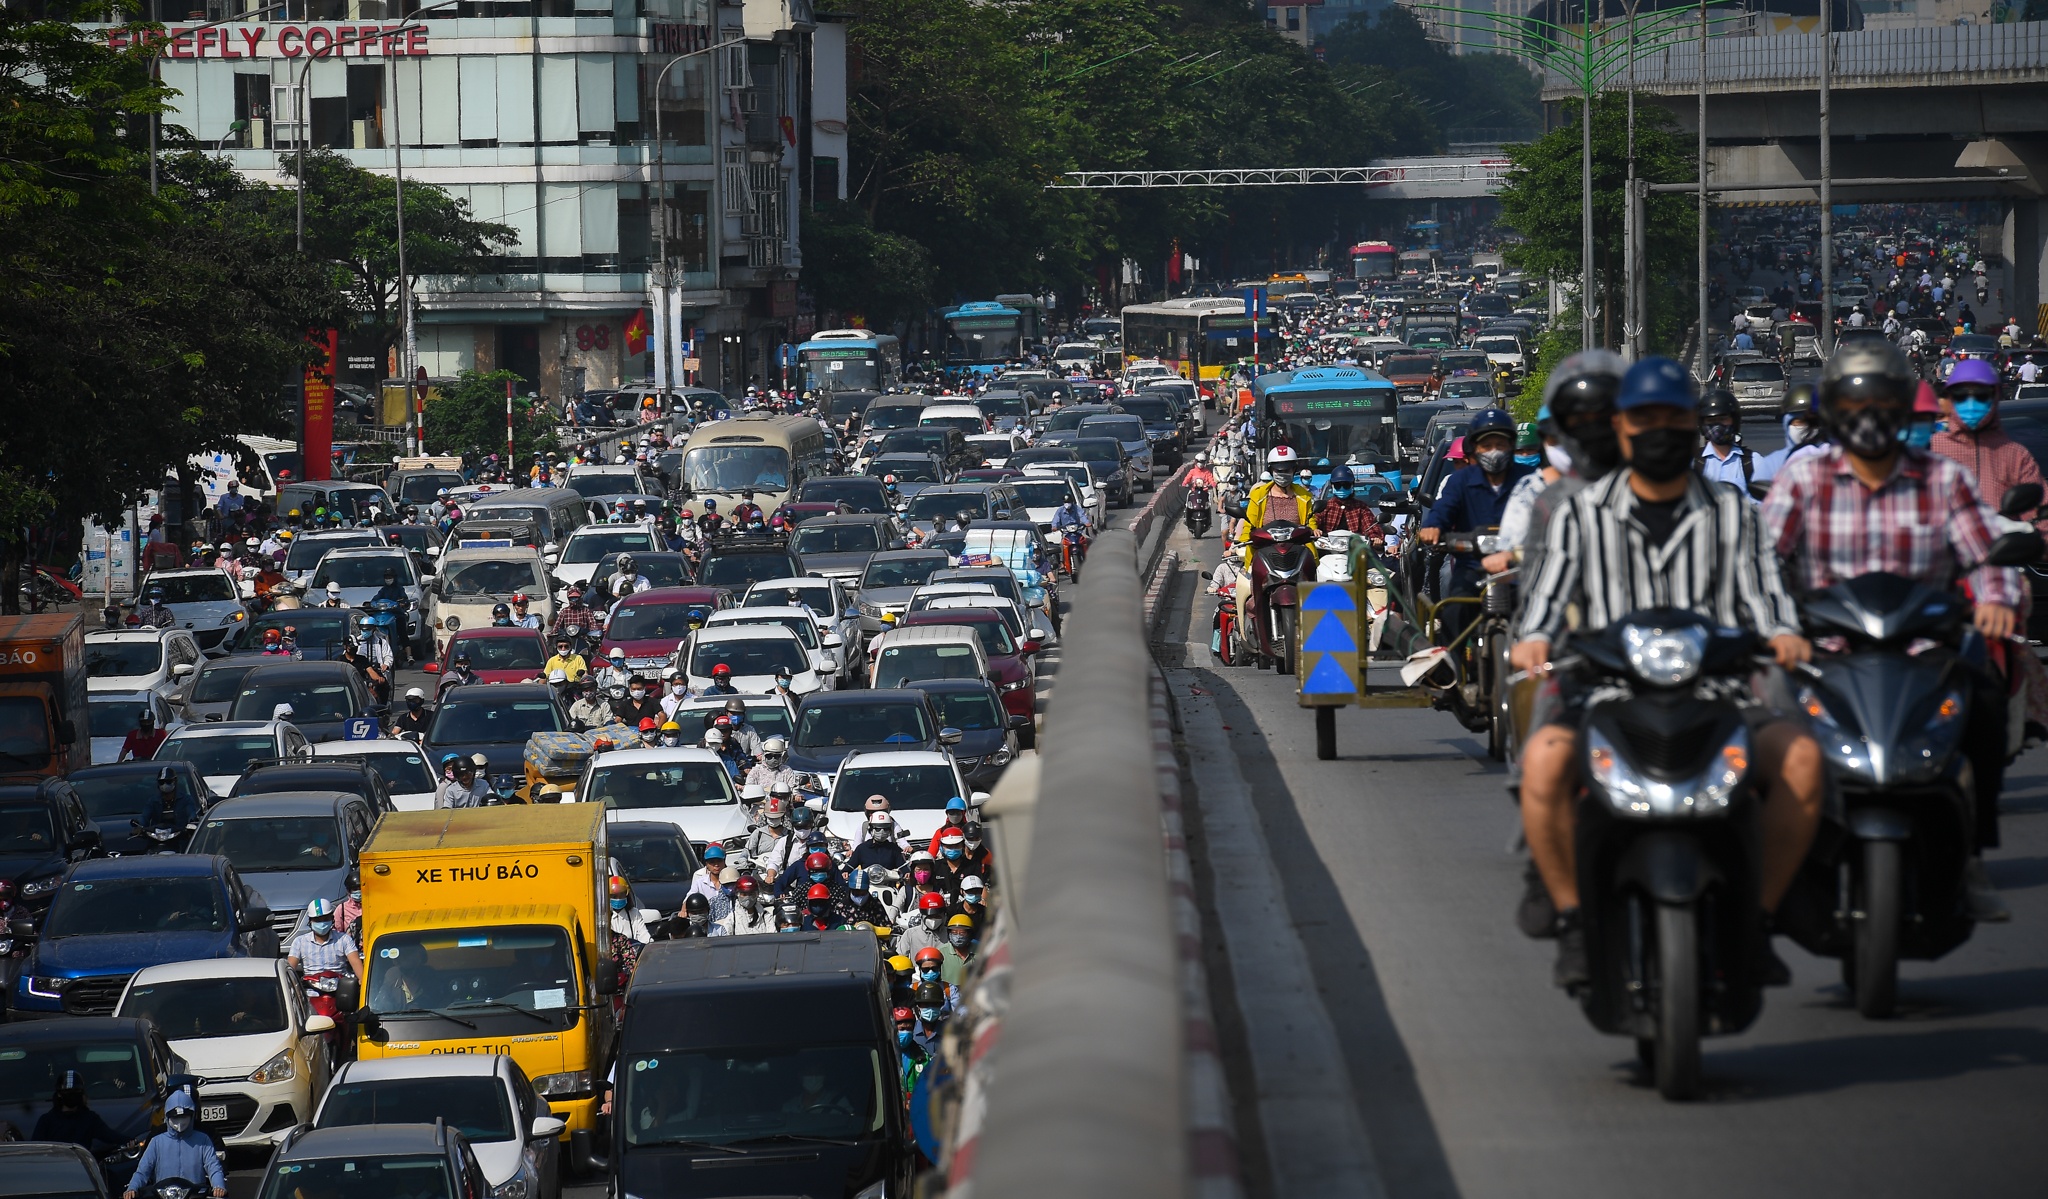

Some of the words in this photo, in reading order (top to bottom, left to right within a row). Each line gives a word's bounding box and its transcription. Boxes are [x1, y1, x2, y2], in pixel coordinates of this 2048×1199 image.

[278, 26, 428, 57] COFFEE
[653, 23, 712, 53] FIREFLY
[576, 324, 610, 351] 93
[1281, 402, 1294, 412] 02
[0, 648, 37, 665] BÁO
[352, 720, 370, 738] G7
[416, 868, 442, 884] XE
[448, 864, 491, 882] THƯ
[497, 860, 539, 880] BÁO
